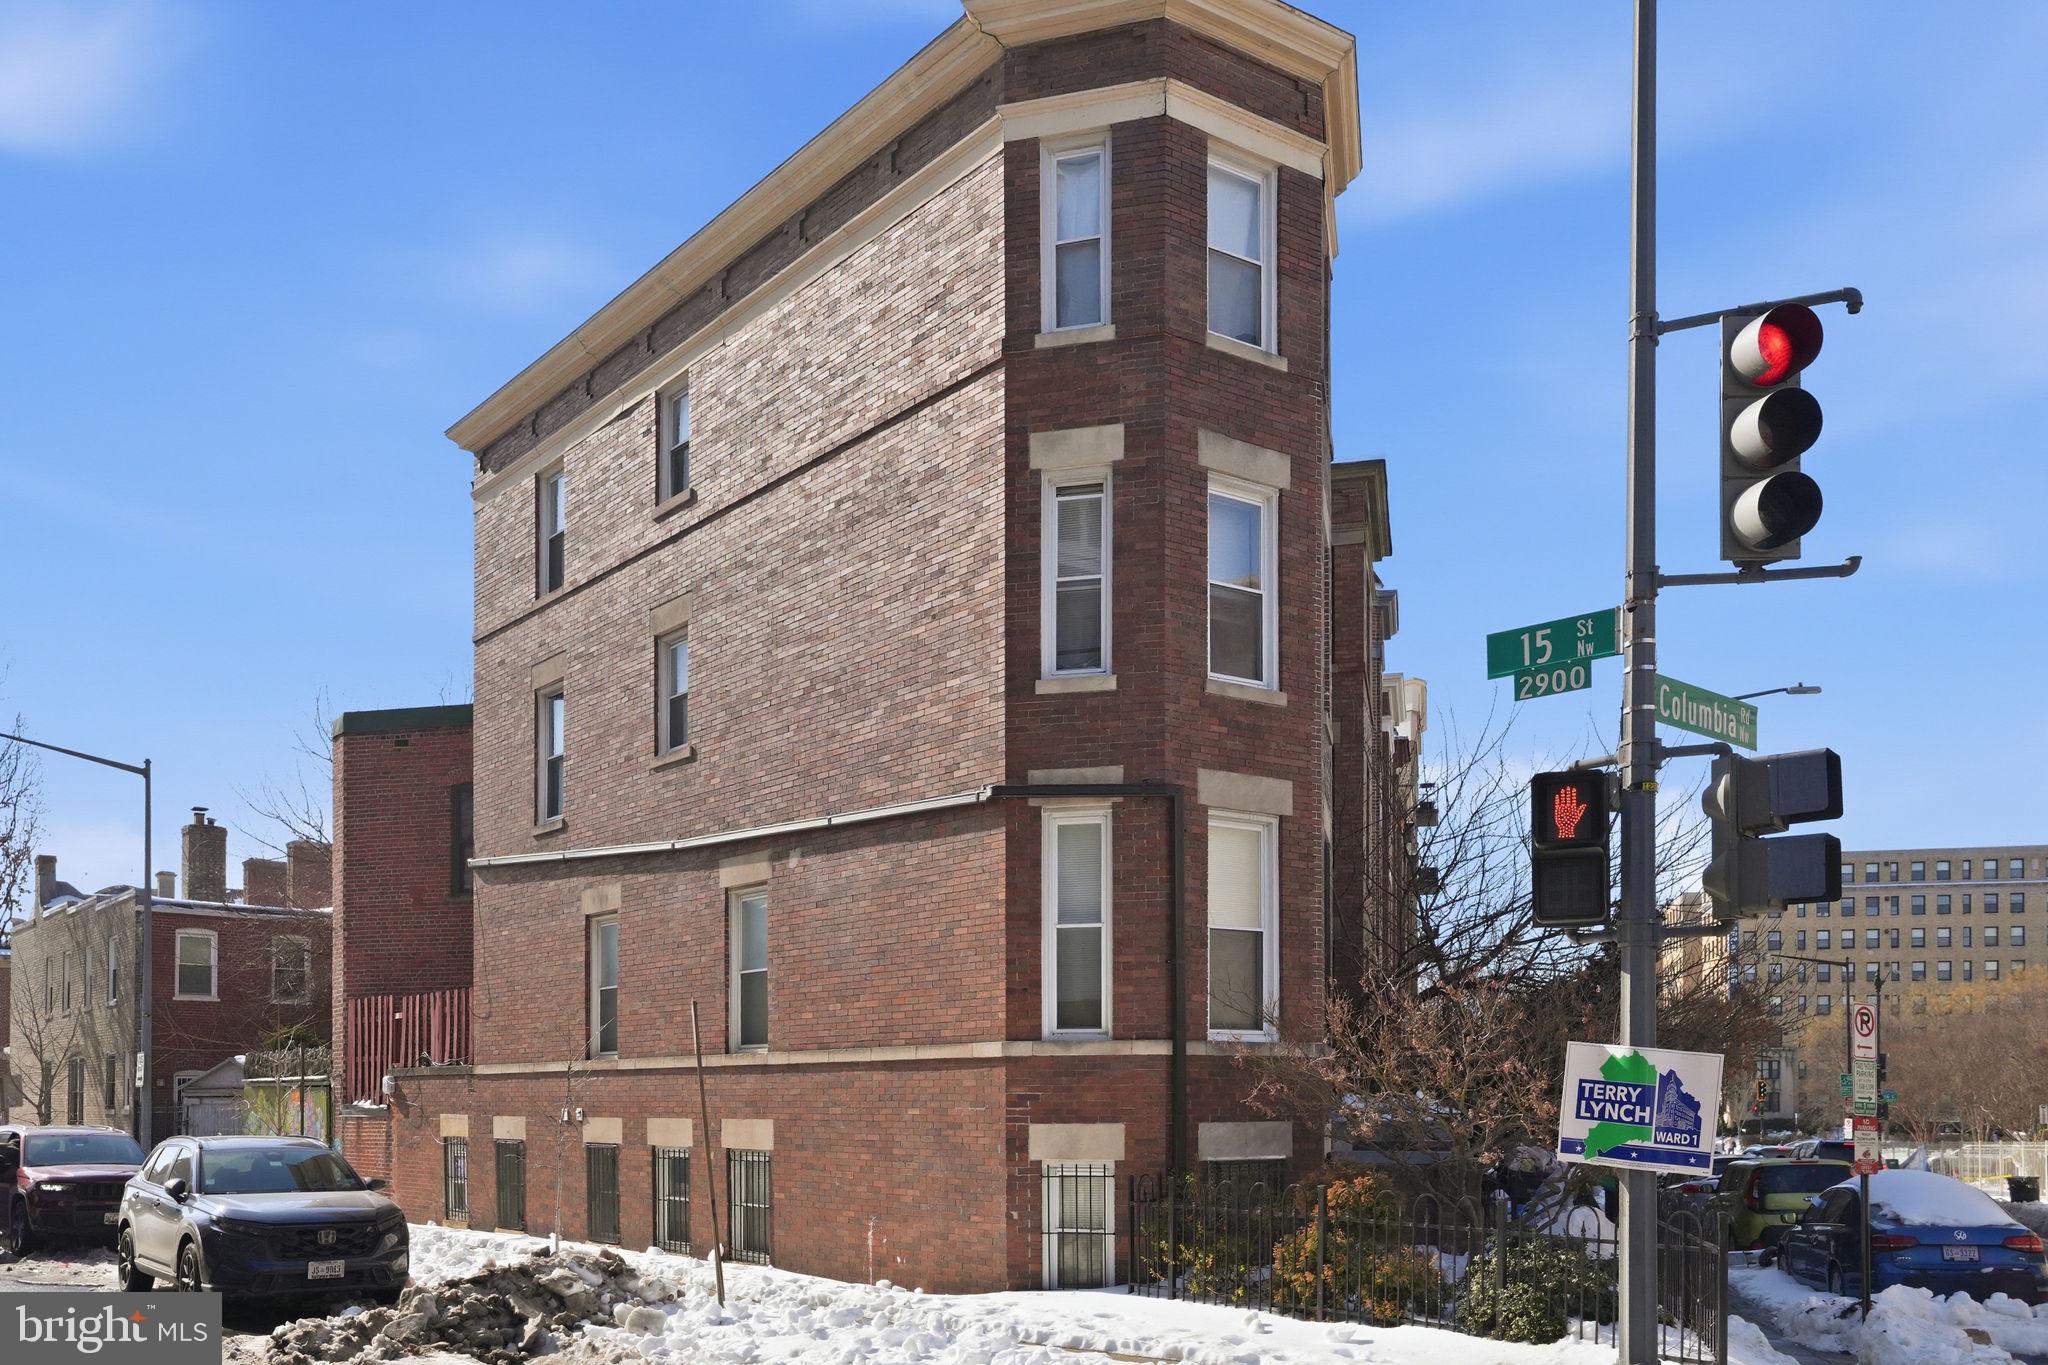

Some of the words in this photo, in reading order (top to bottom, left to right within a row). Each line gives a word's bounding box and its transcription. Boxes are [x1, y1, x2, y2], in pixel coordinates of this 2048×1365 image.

[1520, 628, 1552, 666] 15
[1576, 618, 1594, 637] St
[1519, 665, 1585, 699] 2900
[1660, 684, 1737, 738] Columbia
[1740, 707, 1751, 725] Rd
[1581, 1082, 1642, 1103] TERRY
[1580, 1100, 1651, 1124] LYNCH
[1656, 1131, 1690, 1145] WARD
[1692, 1134, 1698, 1146] 1
